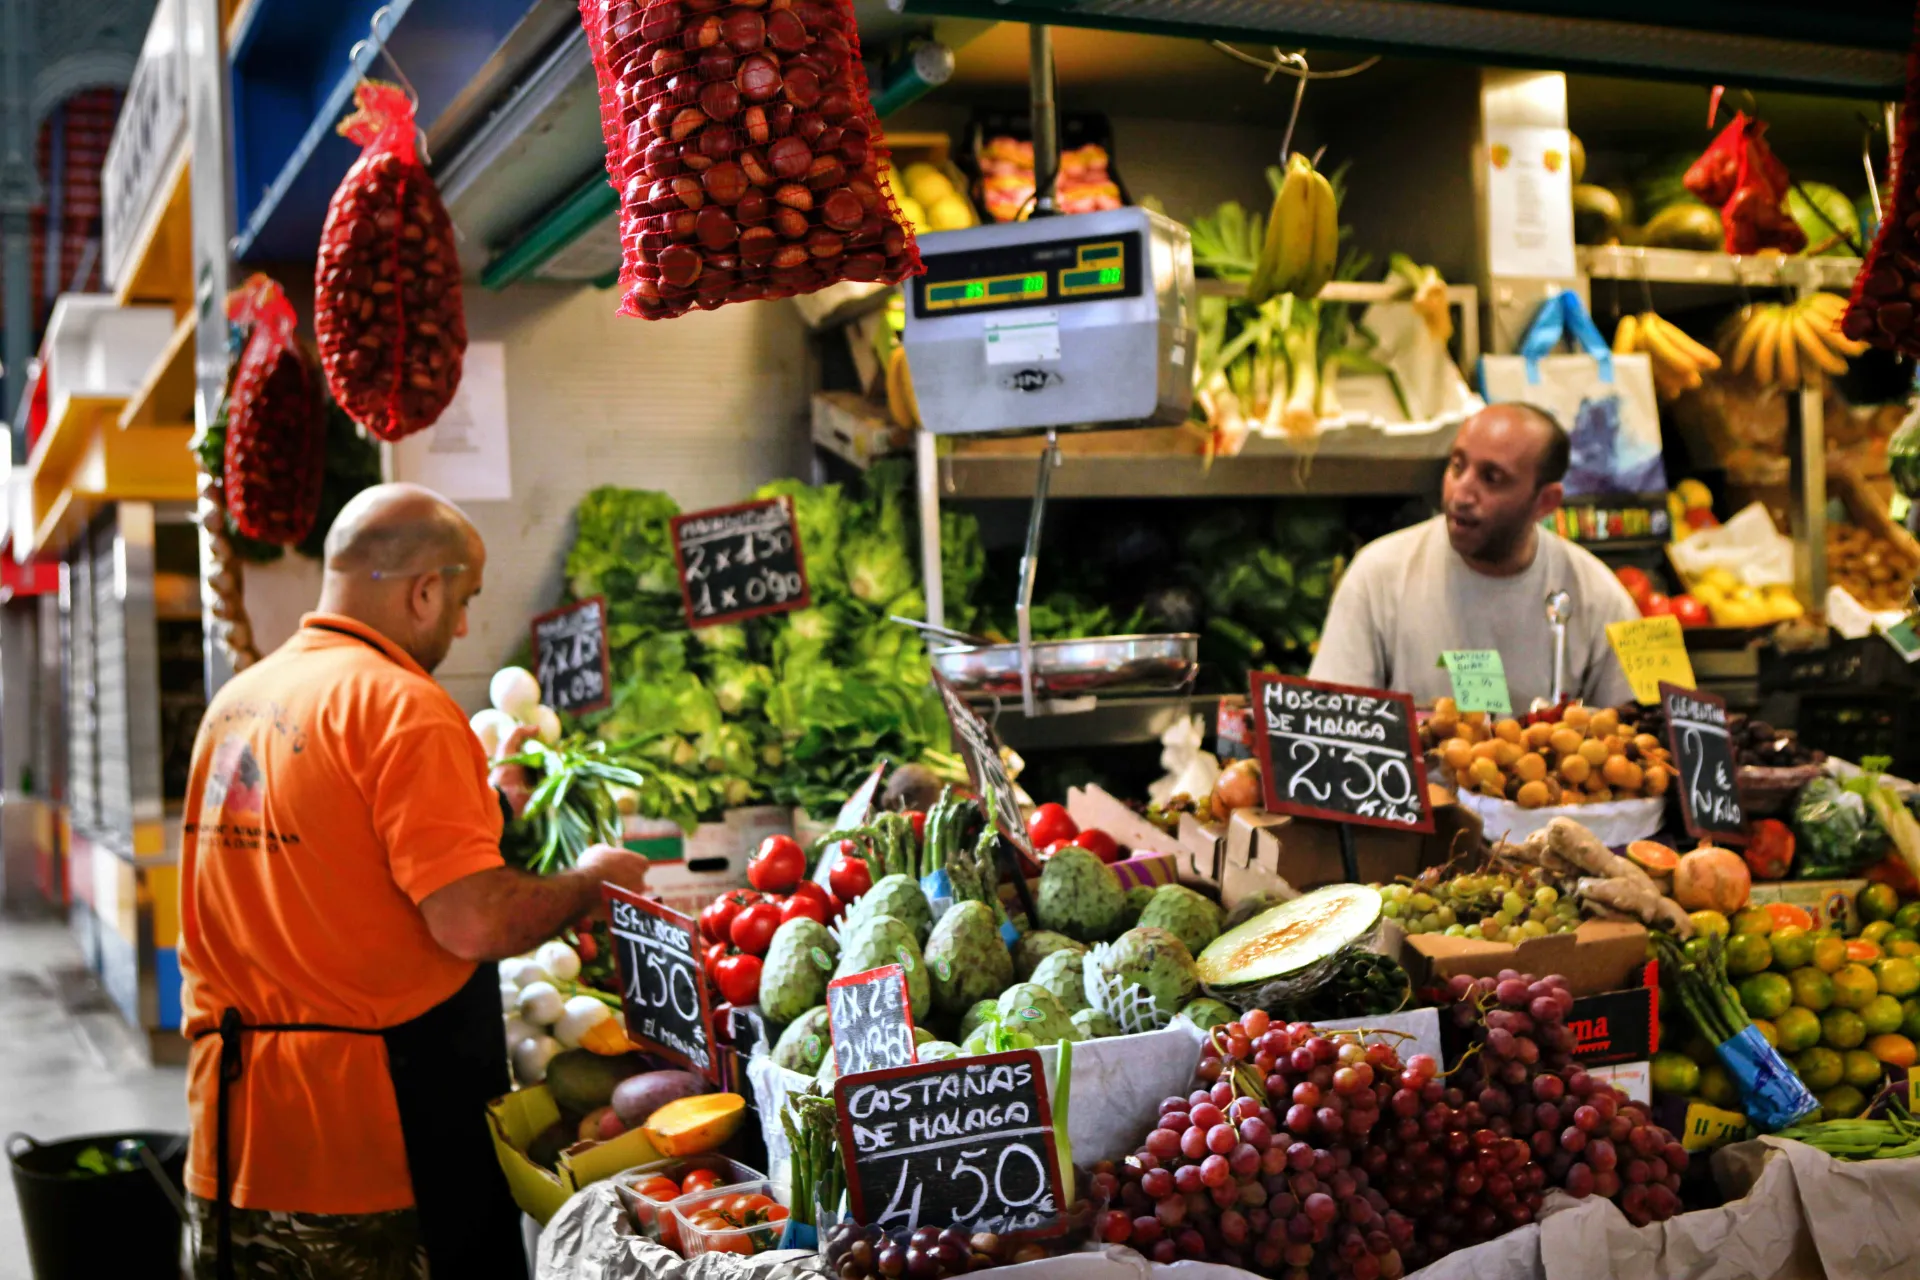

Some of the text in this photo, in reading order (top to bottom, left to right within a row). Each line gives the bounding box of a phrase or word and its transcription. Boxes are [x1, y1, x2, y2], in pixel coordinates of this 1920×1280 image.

[685, 545, 711, 582] 2
[694, 581, 716, 615] 1
[1264, 682, 1399, 721] MOSCATEL
[1266, 707, 1386, 741] DE MALAGA
[1288, 740, 1411, 804] 2'50
[1683, 727, 1712, 820] 2
[848, 1064, 1032, 1118] CASTAÑAS
[852, 1101, 1029, 1152] DE MALAGA
[876, 1143, 1046, 1232] 4'50
